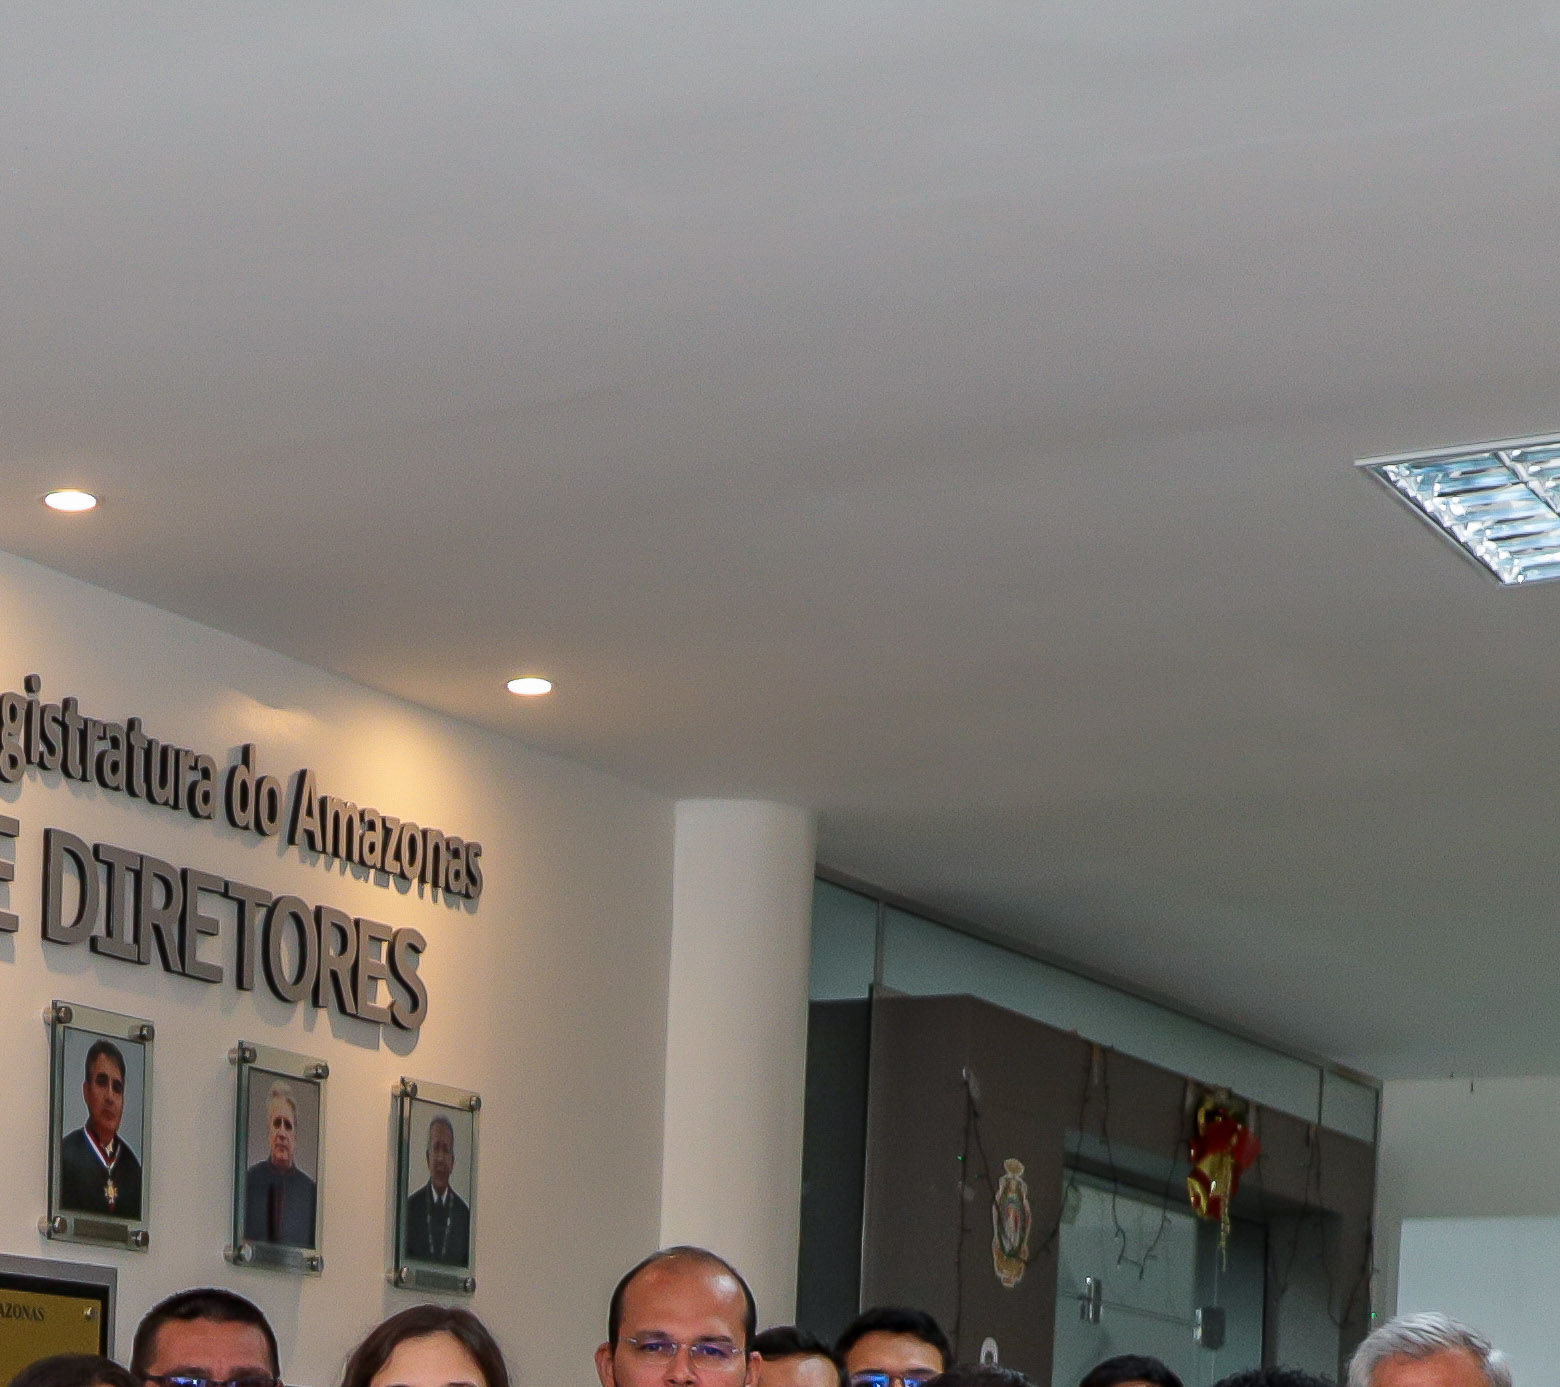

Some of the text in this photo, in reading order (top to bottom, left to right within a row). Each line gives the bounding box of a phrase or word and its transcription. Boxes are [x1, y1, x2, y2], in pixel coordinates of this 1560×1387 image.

[225, 743, 284, 838] do
[287, 768, 484, 901] Amazonas
[41, 826, 429, 1030] DIRETORES
